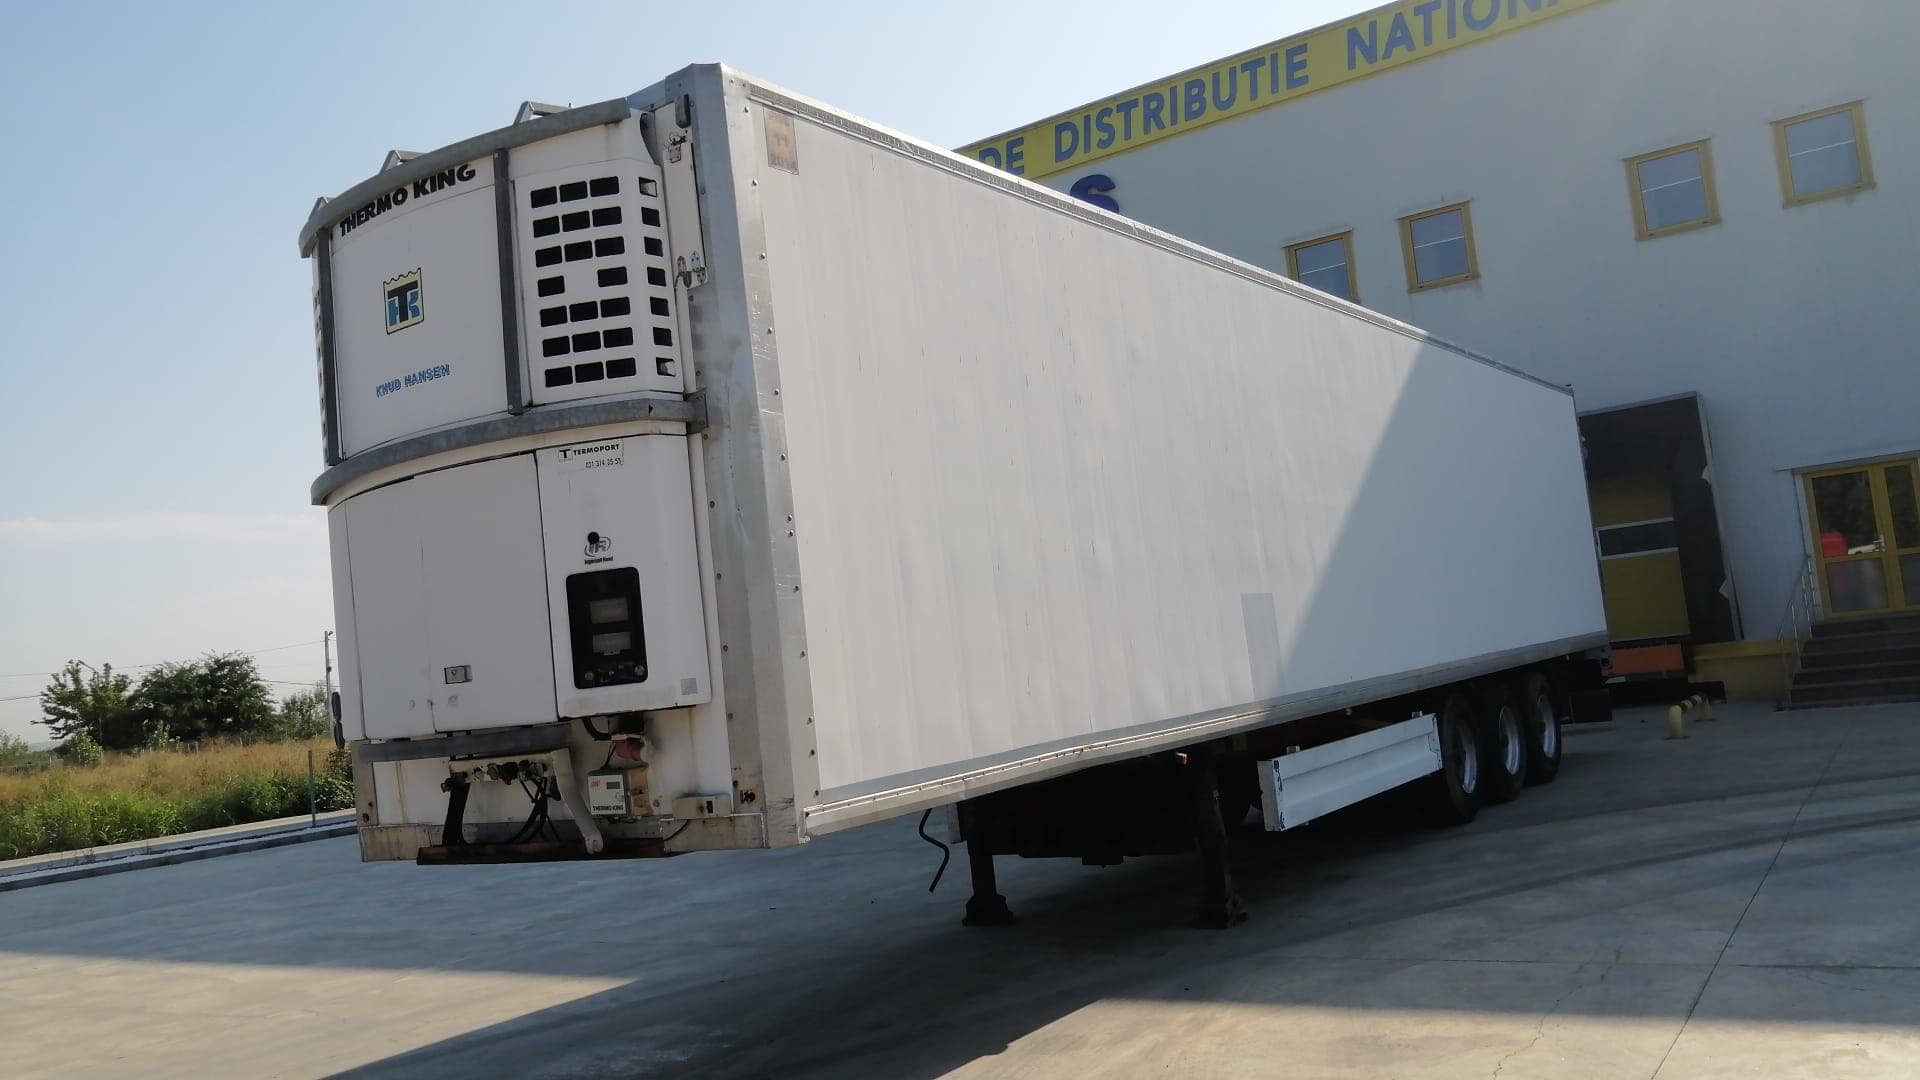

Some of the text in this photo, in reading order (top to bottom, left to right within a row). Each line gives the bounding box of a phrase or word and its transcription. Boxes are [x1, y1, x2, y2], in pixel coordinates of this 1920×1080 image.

[1054, 42, 1309, 164] DISTRIBUTIE
[1346, 0, 1558, 71] NATIO
[340, 163, 476, 237] THERMO KING
[376, 363, 451, 398] KNUD HANSEN
[573, 444, 620, 456] TERMOPORT
